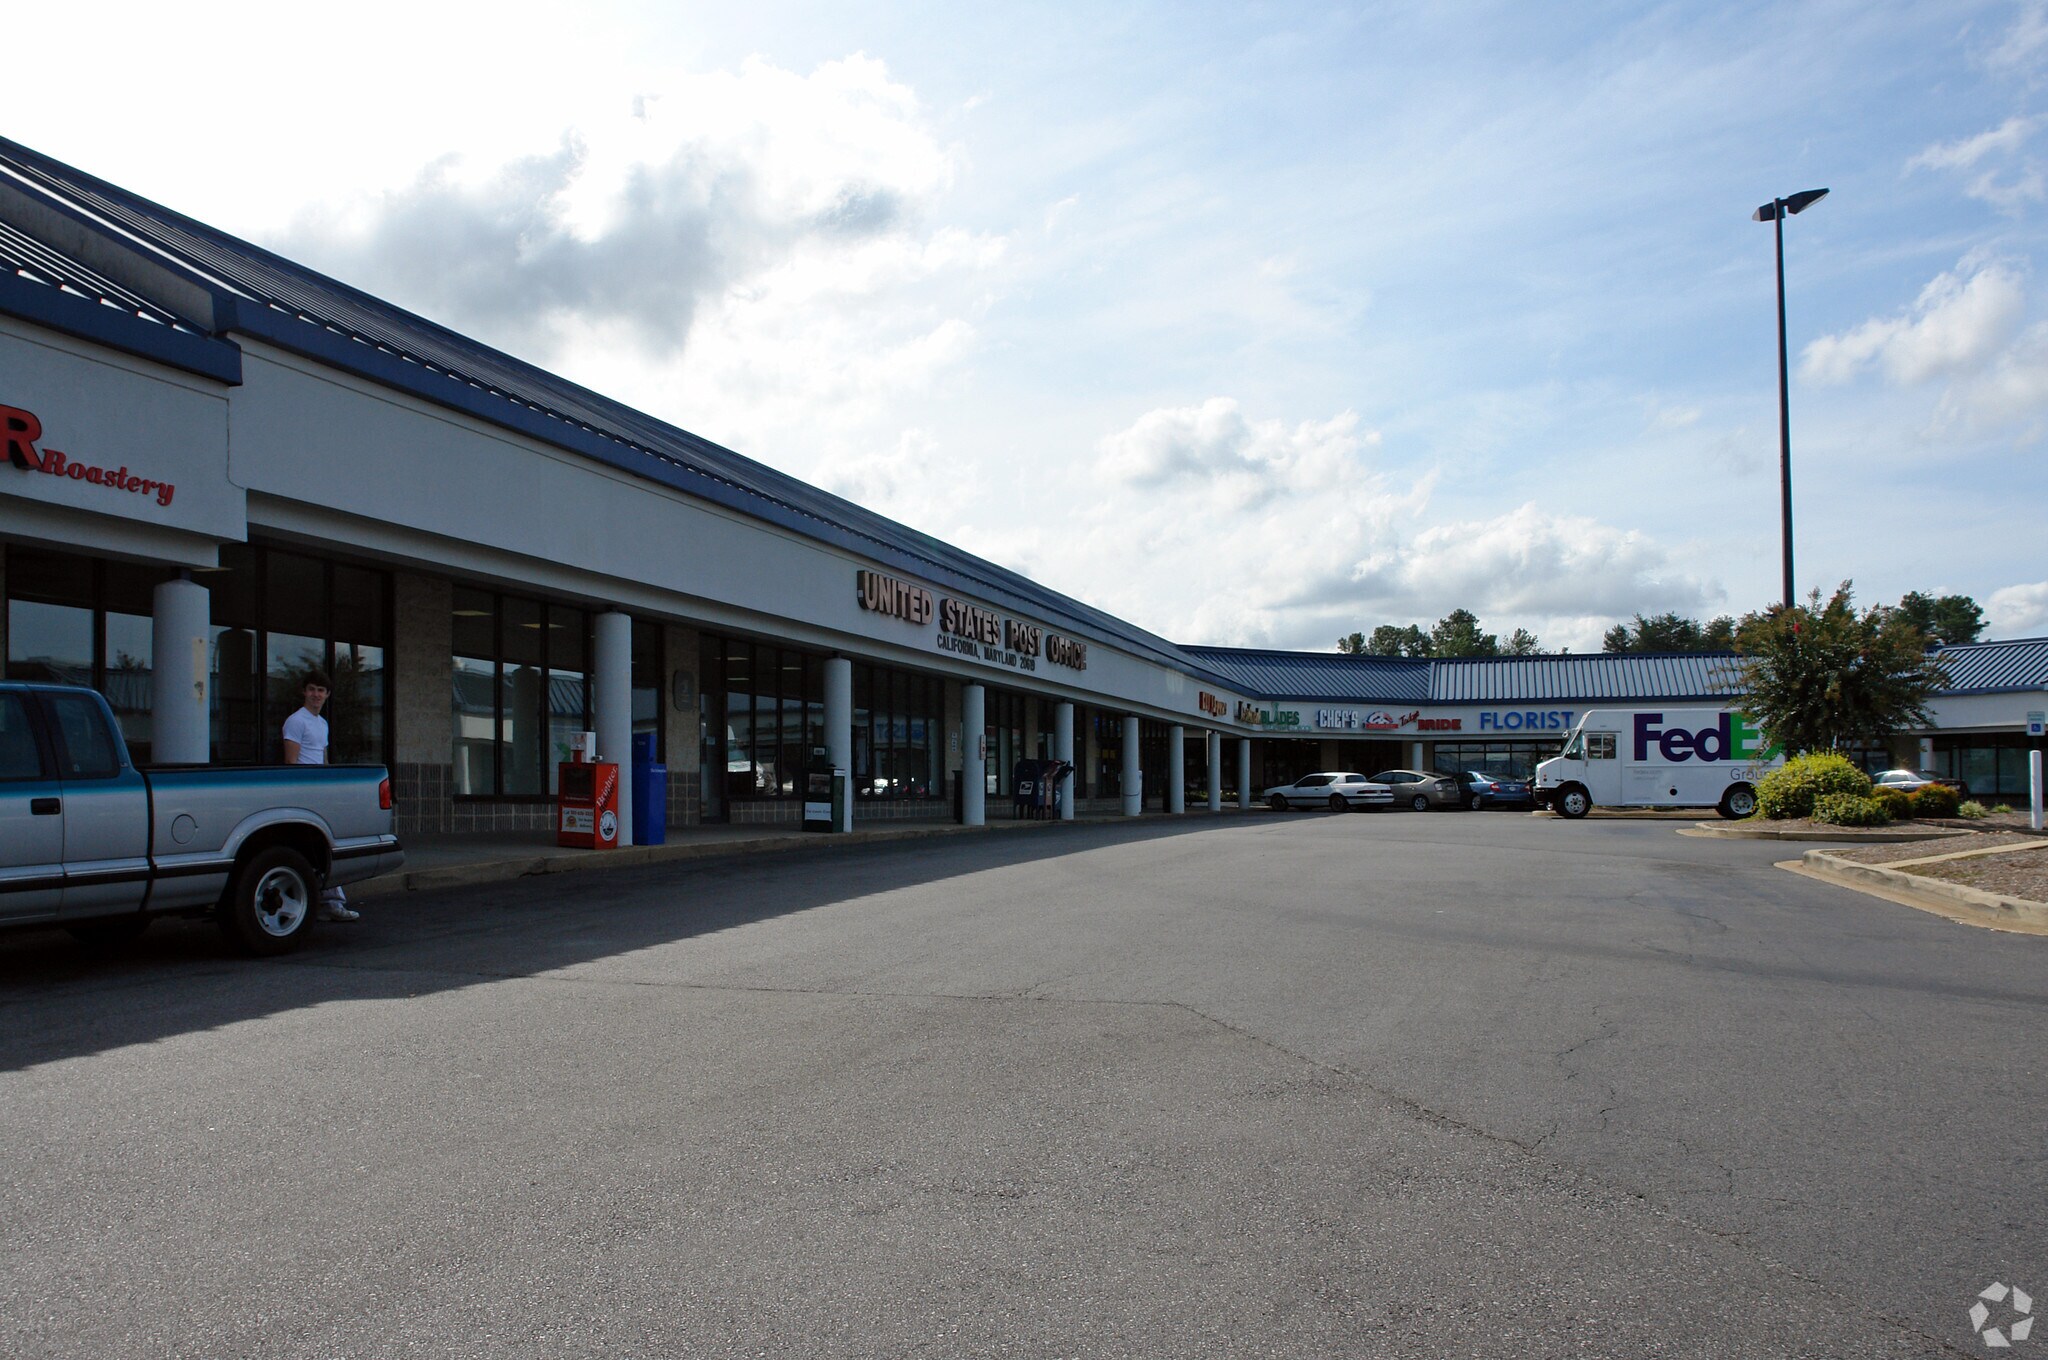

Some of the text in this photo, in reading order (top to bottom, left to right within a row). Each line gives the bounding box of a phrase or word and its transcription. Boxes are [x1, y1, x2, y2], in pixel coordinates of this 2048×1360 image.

[38, 448, 175, 506] Roastery
[857, 570, 1087, 671] UNITED STATES POST OFFICE
[937, 634, 981, 660] CALIFORNIA,
[984, 646, 1017, 668] MARYLAND
[1260, 709, 1300, 726] BLADES
[1317, 709, 1359, 729] CHEF'S
[1417, 719, 1462, 731] BRIDE
[1480, 711, 1574, 730] FLORIST
